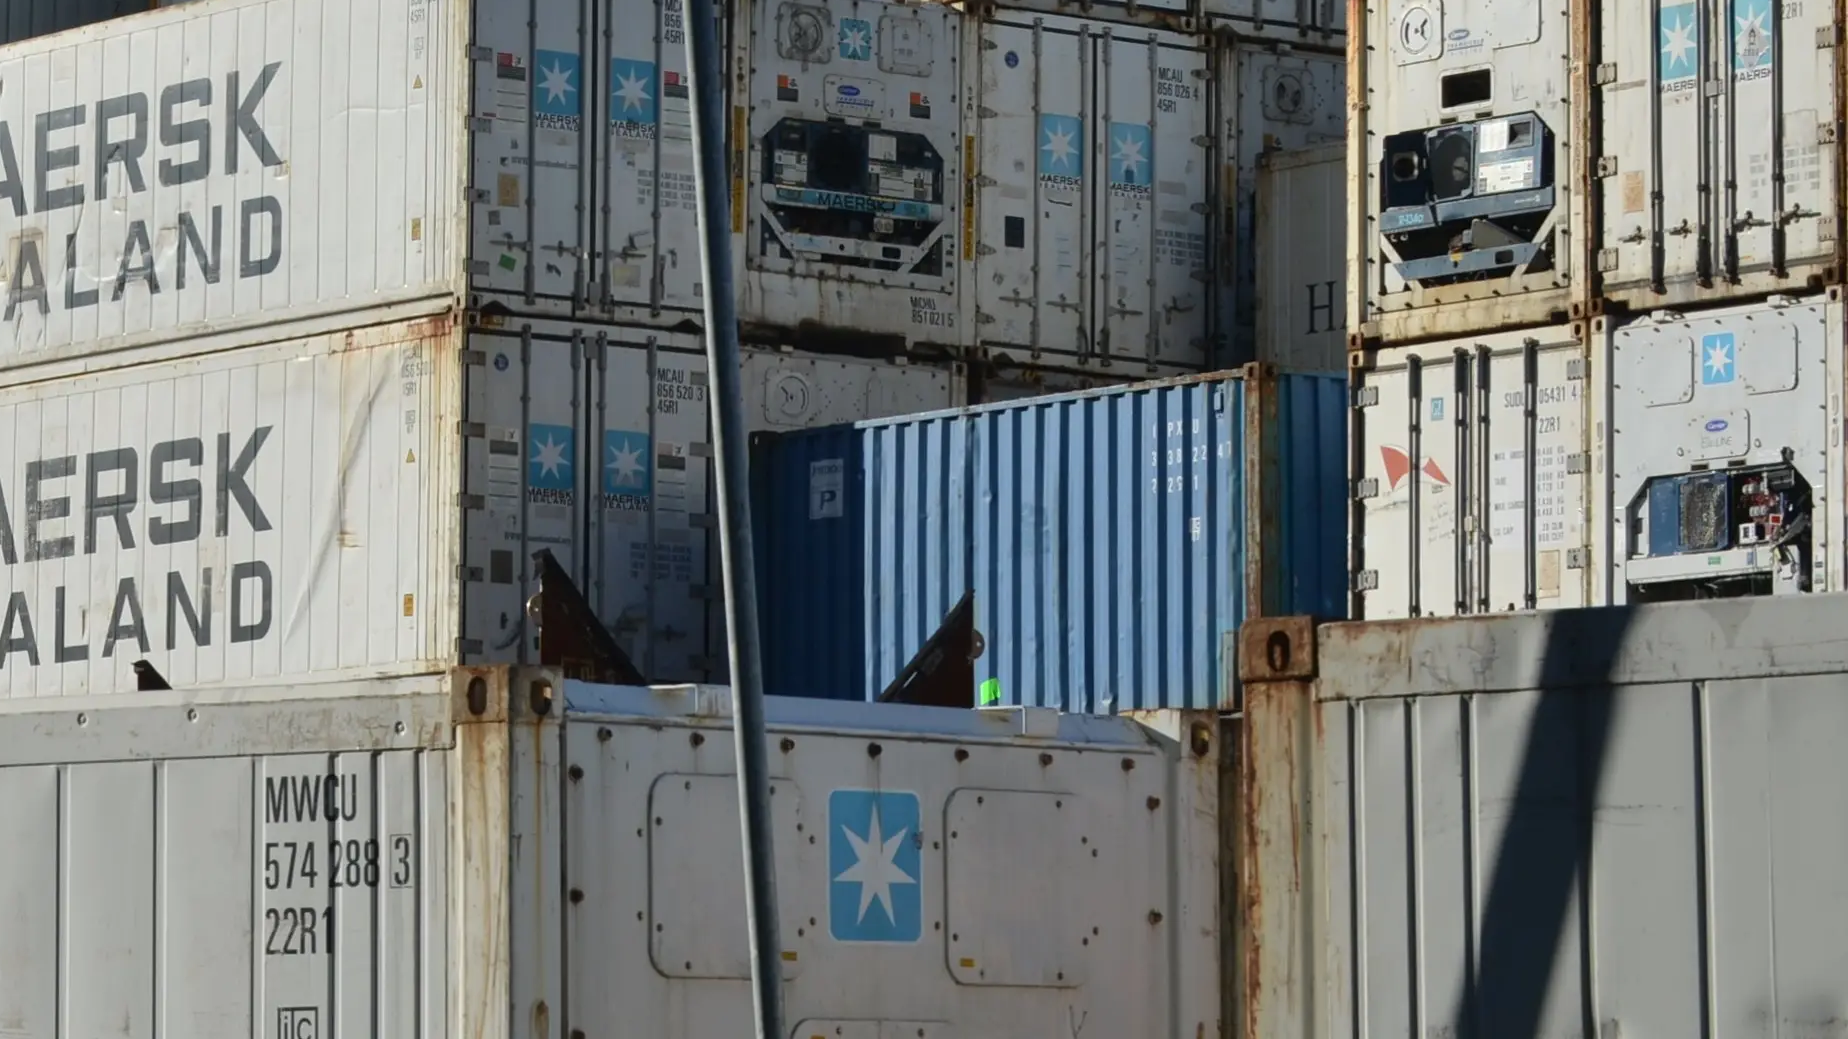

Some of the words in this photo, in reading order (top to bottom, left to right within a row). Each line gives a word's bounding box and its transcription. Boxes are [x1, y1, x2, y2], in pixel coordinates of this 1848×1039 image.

[664, 13, 682, 29] 856
[663, 29, 685, 45] 45R1
[1158, 66, 1183, 84] MCAU
[1157, 82, 1173, 97] 856
[1175, 84, 1190, 99] 026
[1193, 87, 1199, 101] 4
[1157, 98, 1177, 114] 45R1
[535, 111, 579, 126] MAERSK
[611, 120, 655, 133] MAERSK
[1305, 280, 1346, 336] H
[947, 313, 954, 329] 5
[658, 367, 684, 384] MCAU
[657, 382, 674, 399] 856
[676, 385, 694, 401] 520
[697, 387, 704, 402] 3
[657, 399, 678, 415] 45R1
[1538, 416, 1561, 434] 22R1
[819, 490, 837, 511] P
[265, 773, 357, 824] MWCU
[265, 841, 318, 890] 574
[329, 838, 380, 888] 288
[394, 836, 411, 886] 3
[265, 906, 333, 956] 22R1
